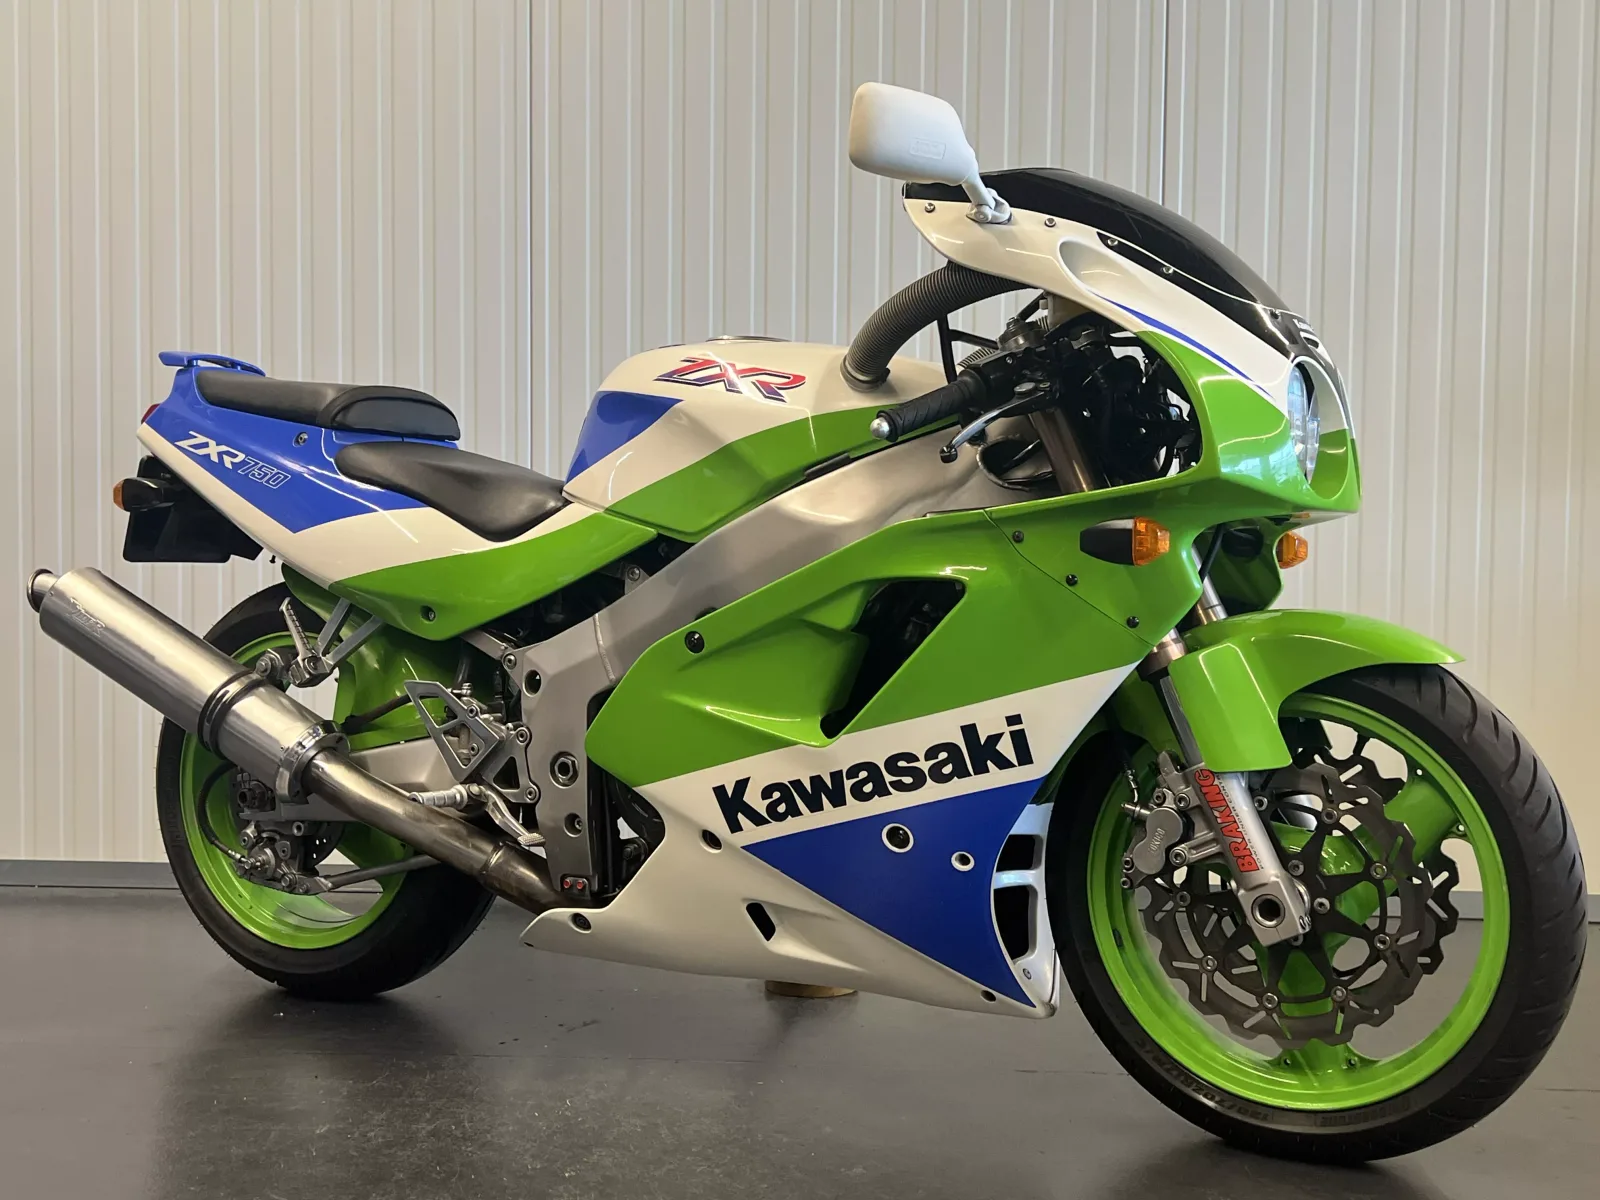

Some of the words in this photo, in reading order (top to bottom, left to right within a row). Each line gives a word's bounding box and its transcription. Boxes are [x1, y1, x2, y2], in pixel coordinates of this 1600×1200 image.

[653, 356, 807, 403] ZXR
[712, 713, 1034, 835] Kawasaki
[1194, 768, 1260, 872] BRAKING
